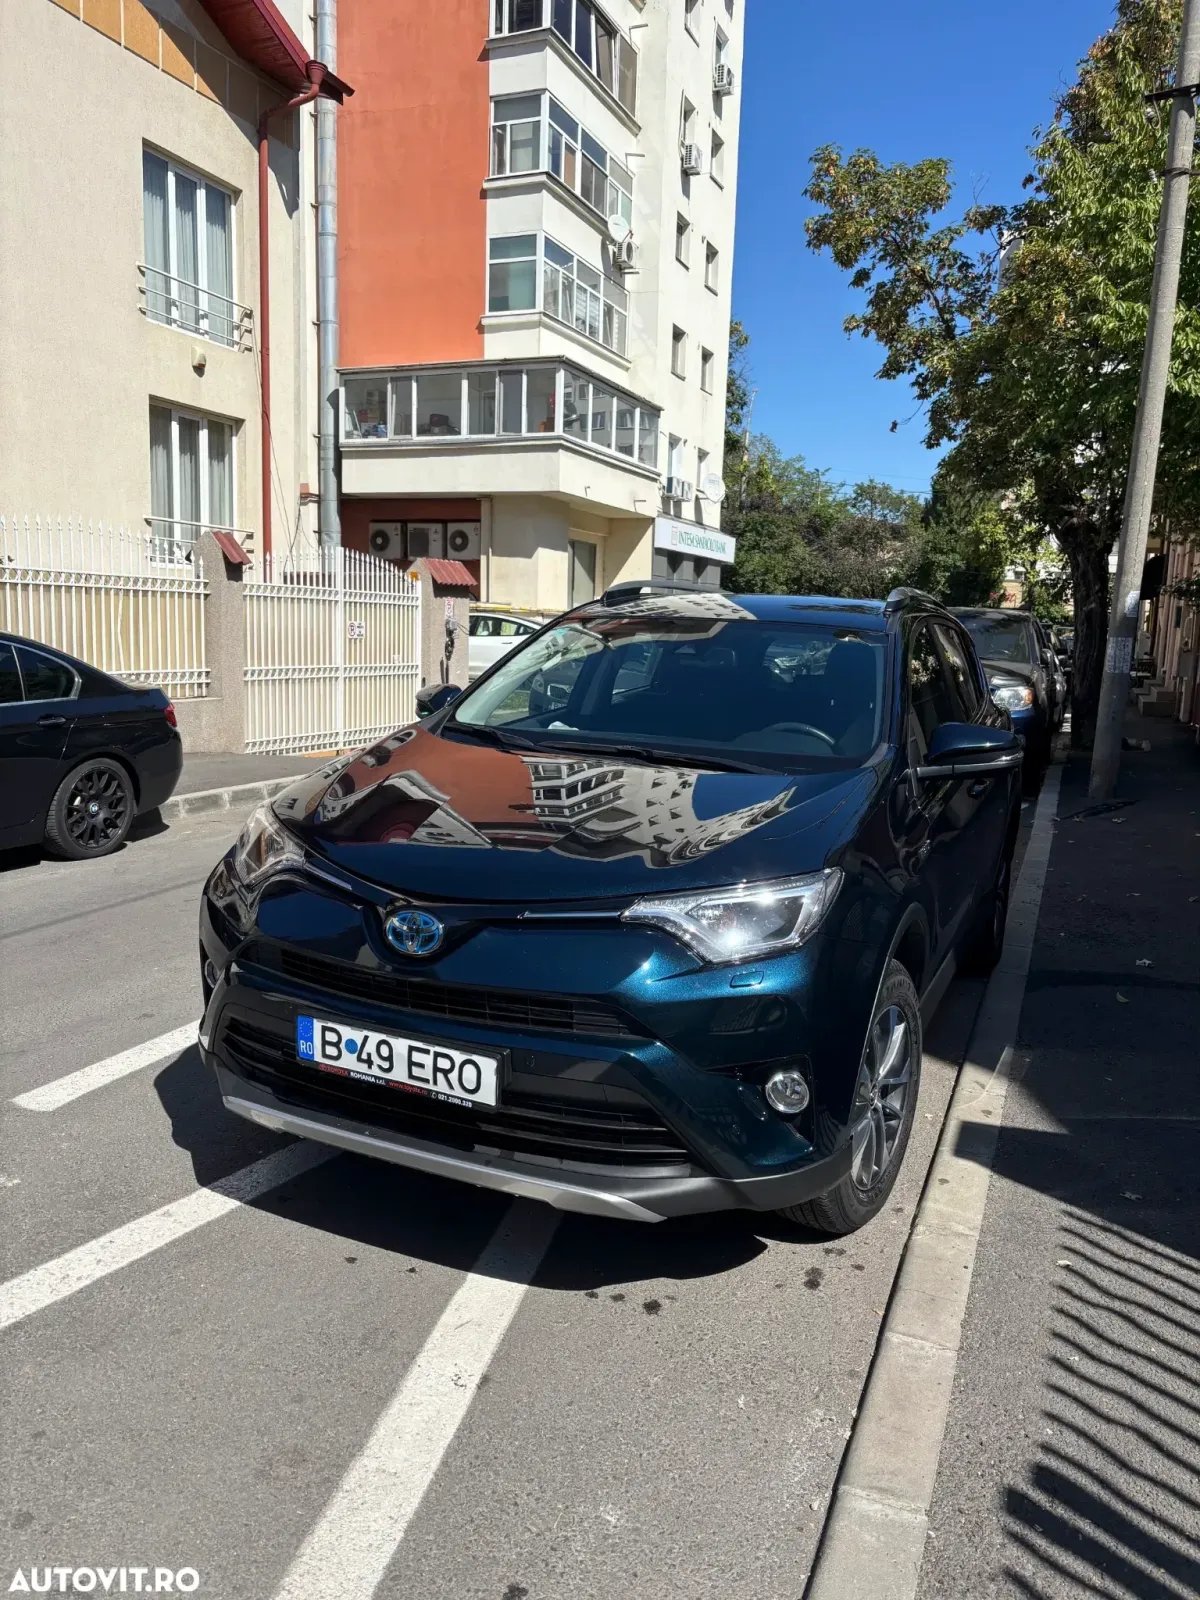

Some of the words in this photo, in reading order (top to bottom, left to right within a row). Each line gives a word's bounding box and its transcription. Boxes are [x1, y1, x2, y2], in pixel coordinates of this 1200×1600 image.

[300, 1039, 313, 1055] RO
[320, 1024, 343, 1061] B
[356, 1035, 395, 1074] 49
[407, 1044, 482, 1096] ERO
[350, 1071, 376, 1083] ROMANIA
